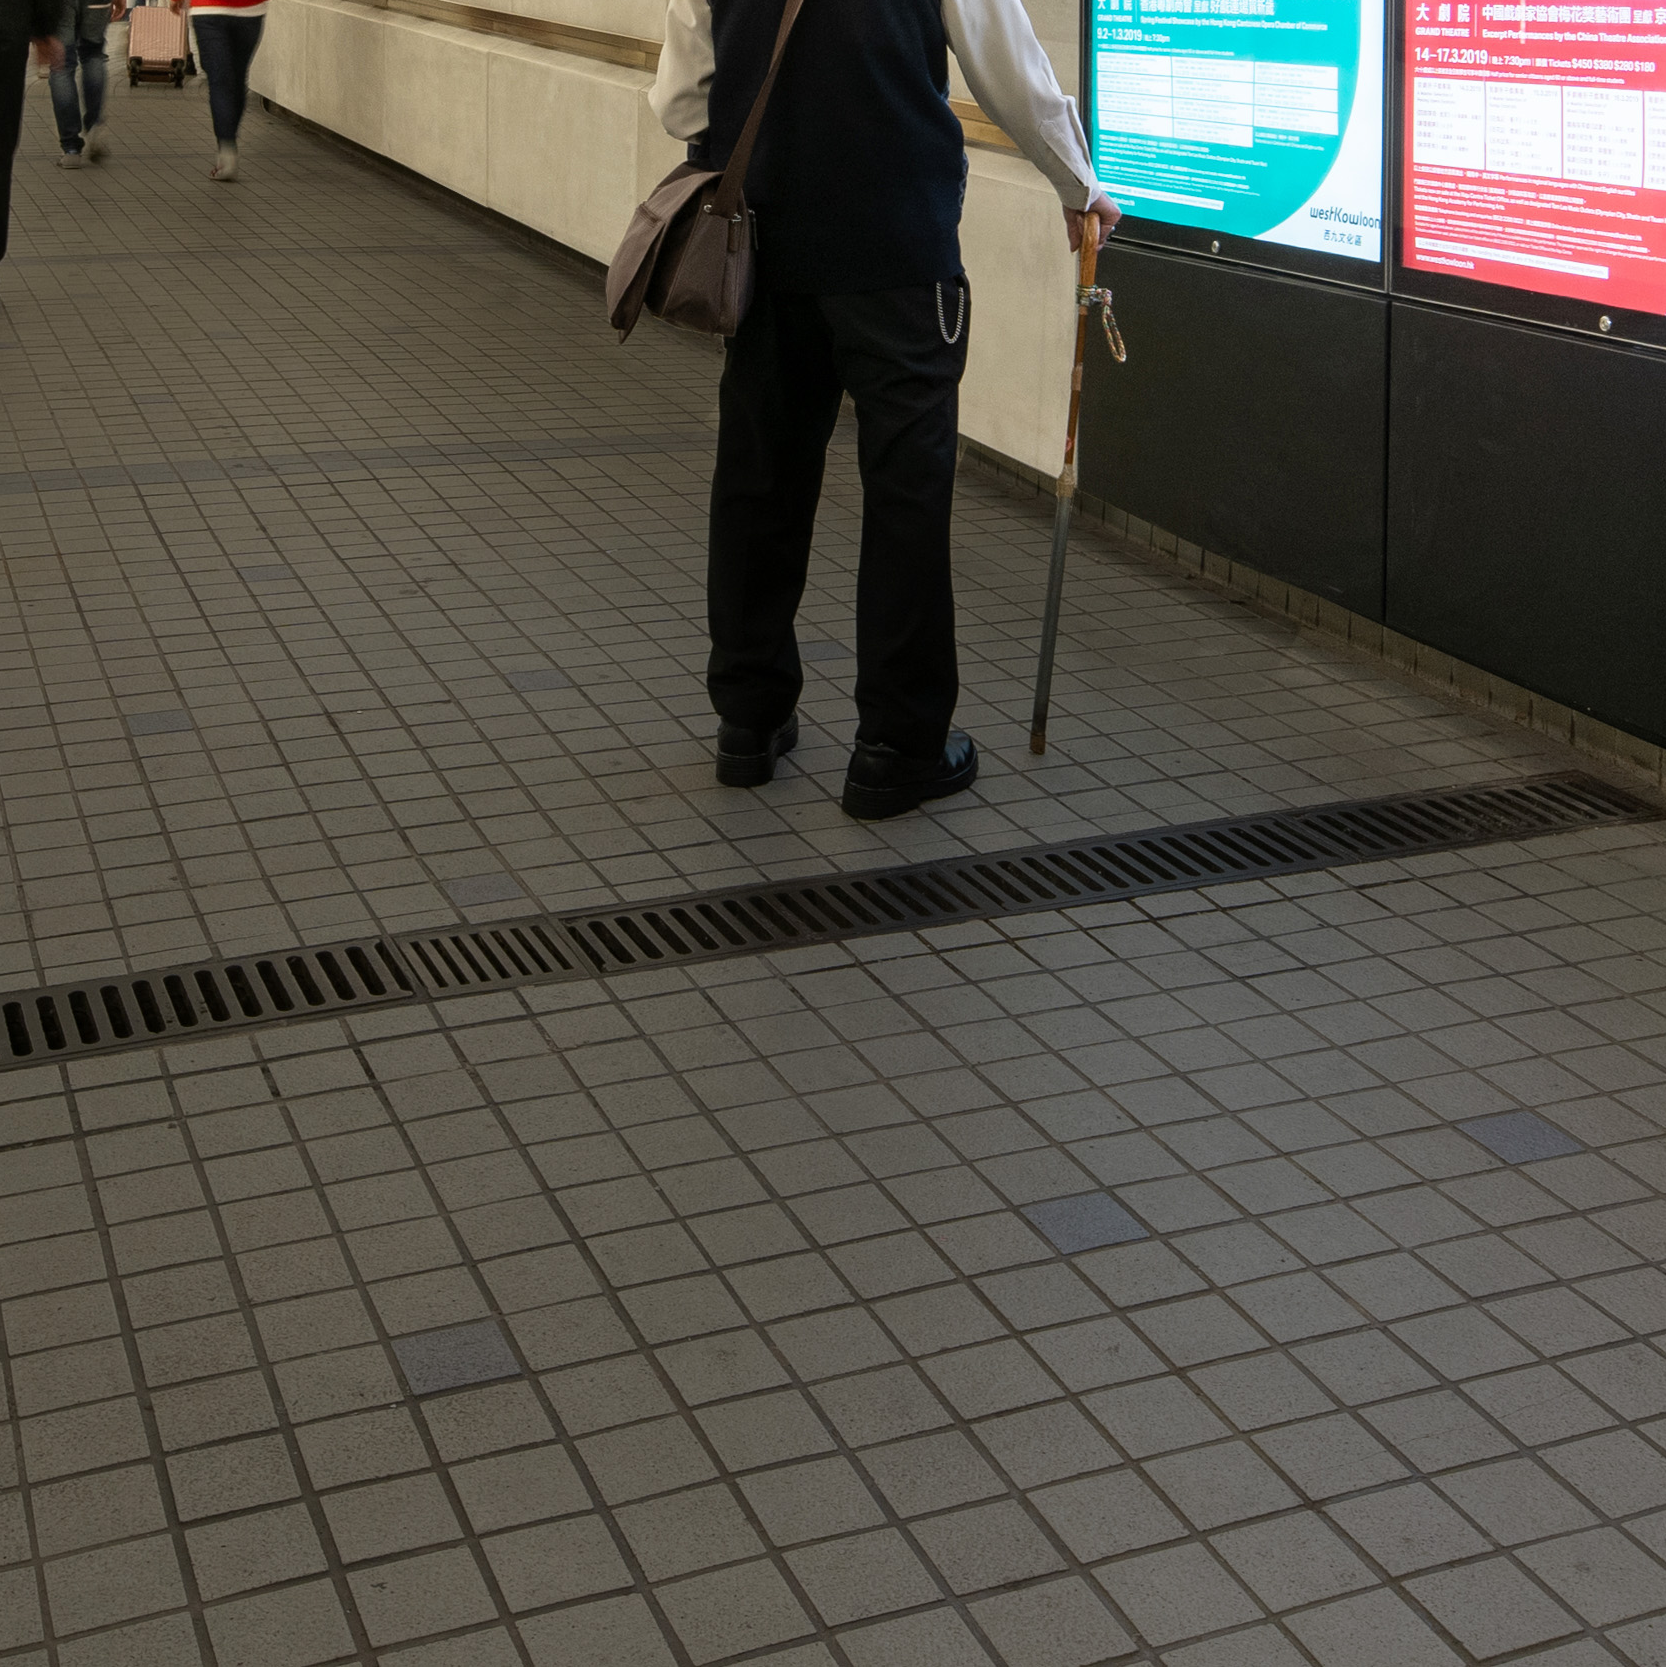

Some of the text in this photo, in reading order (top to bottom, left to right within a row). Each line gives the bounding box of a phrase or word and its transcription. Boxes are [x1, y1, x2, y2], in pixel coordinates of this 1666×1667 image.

[1415, 3, 1470, 22] 大劇院
[1547, 59, 1572, 68] Tickets
[1570, 58, 1593, 69] $450
[1310, 207, 1381, 230] westKowloon
